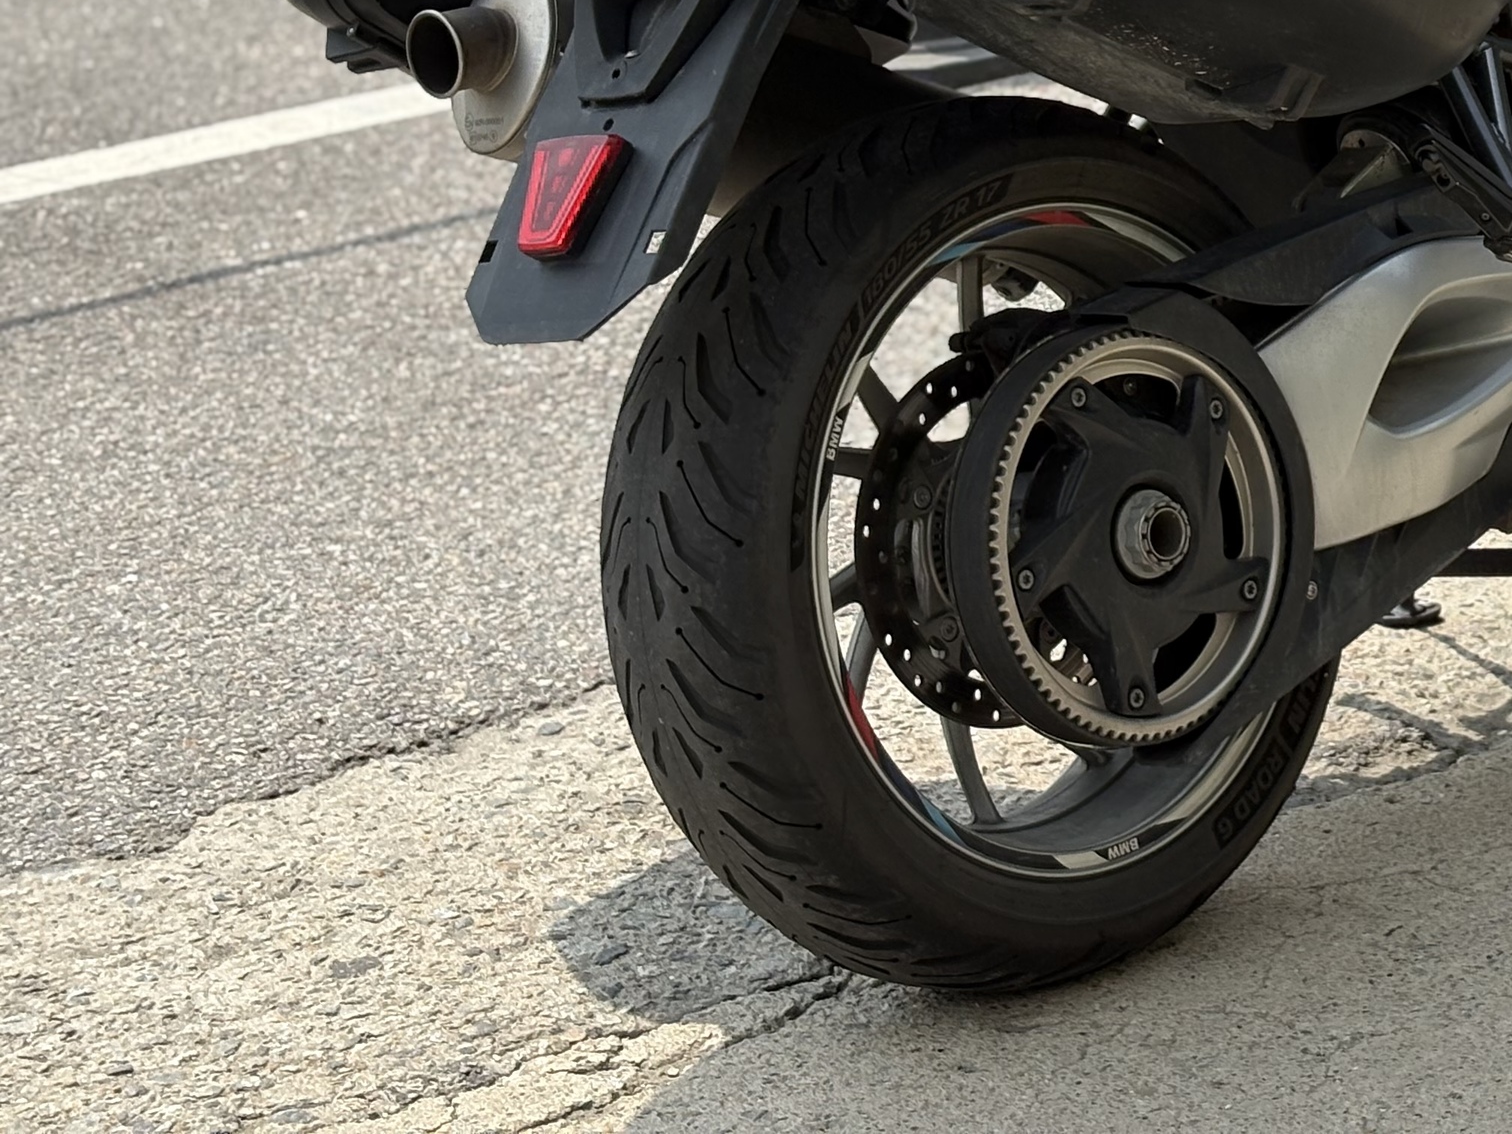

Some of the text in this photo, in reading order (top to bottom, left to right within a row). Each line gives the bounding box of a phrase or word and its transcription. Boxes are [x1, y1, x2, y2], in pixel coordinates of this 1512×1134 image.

[863, 180, 1002, 304] 180/55 ZR 17
[826, 415, 844, 462] BMW
[1234, 750, 1284, 820] ROAD
[1108, 837, 1139, 860] BMW
